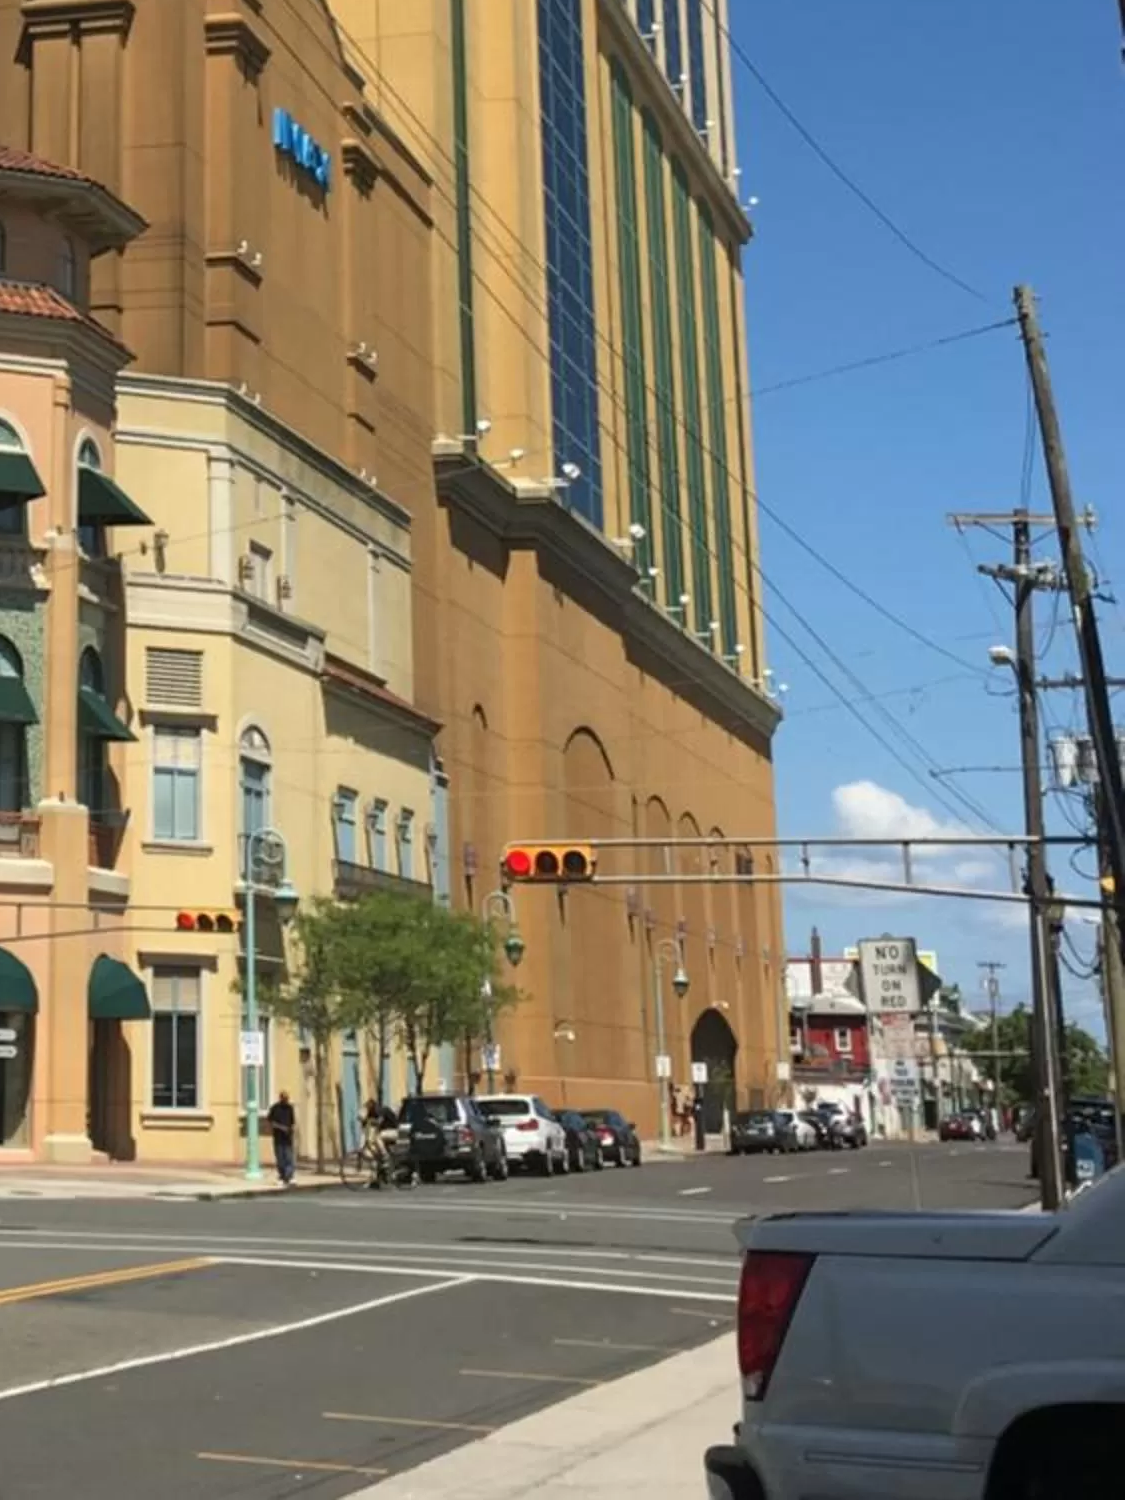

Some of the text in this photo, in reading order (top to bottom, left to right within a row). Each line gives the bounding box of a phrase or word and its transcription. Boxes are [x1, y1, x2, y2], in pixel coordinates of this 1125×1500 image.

[875, 945, 900, 961] NO
[873, 963, 907, 976] TURN
[881, 979, 902, 992] ON
[881, 995, 907, 1008] RED
